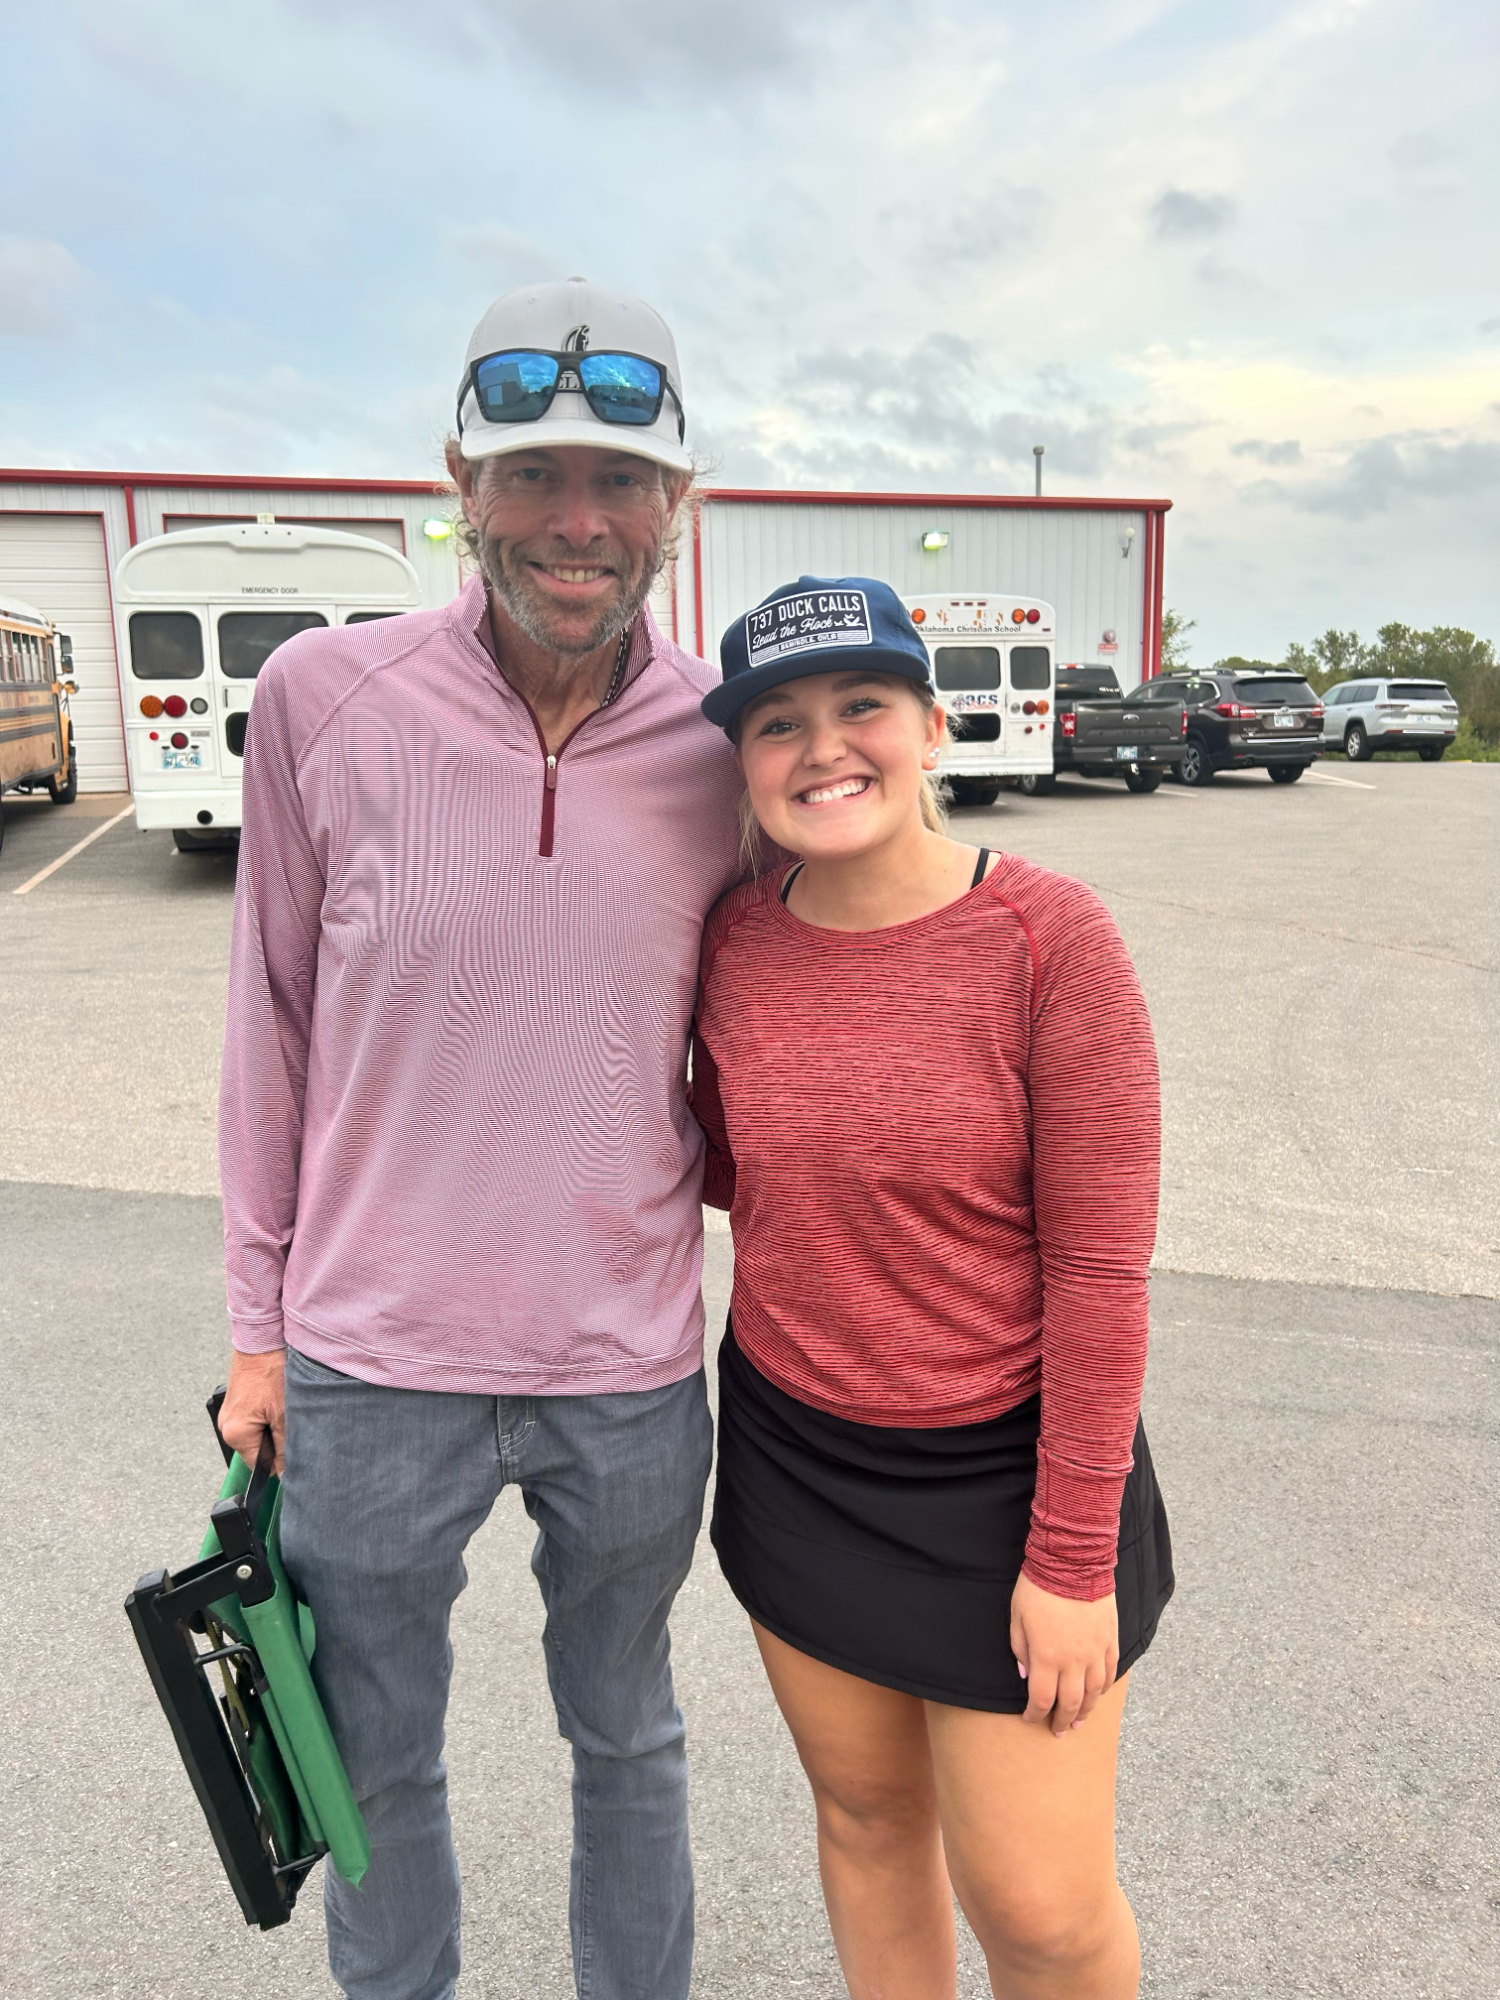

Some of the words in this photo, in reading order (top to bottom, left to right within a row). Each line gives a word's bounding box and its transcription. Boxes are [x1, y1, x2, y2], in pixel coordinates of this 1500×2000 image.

[241, 586, 279, 594] EMERGENCY
[750, 609, 773, 633] 737
[778, 598, 815, 622] DUCK
[818, 595, 861, 613] CALLS
[752, 627, 778, 650] Lead
[779, 623, 797, 639] the
[799, 615, 833, 634] Flock
[914, 625, 954, 633] Oklahoma
[956, 625, 993, 633] Christian
[994, 625, 1021, 633] School
